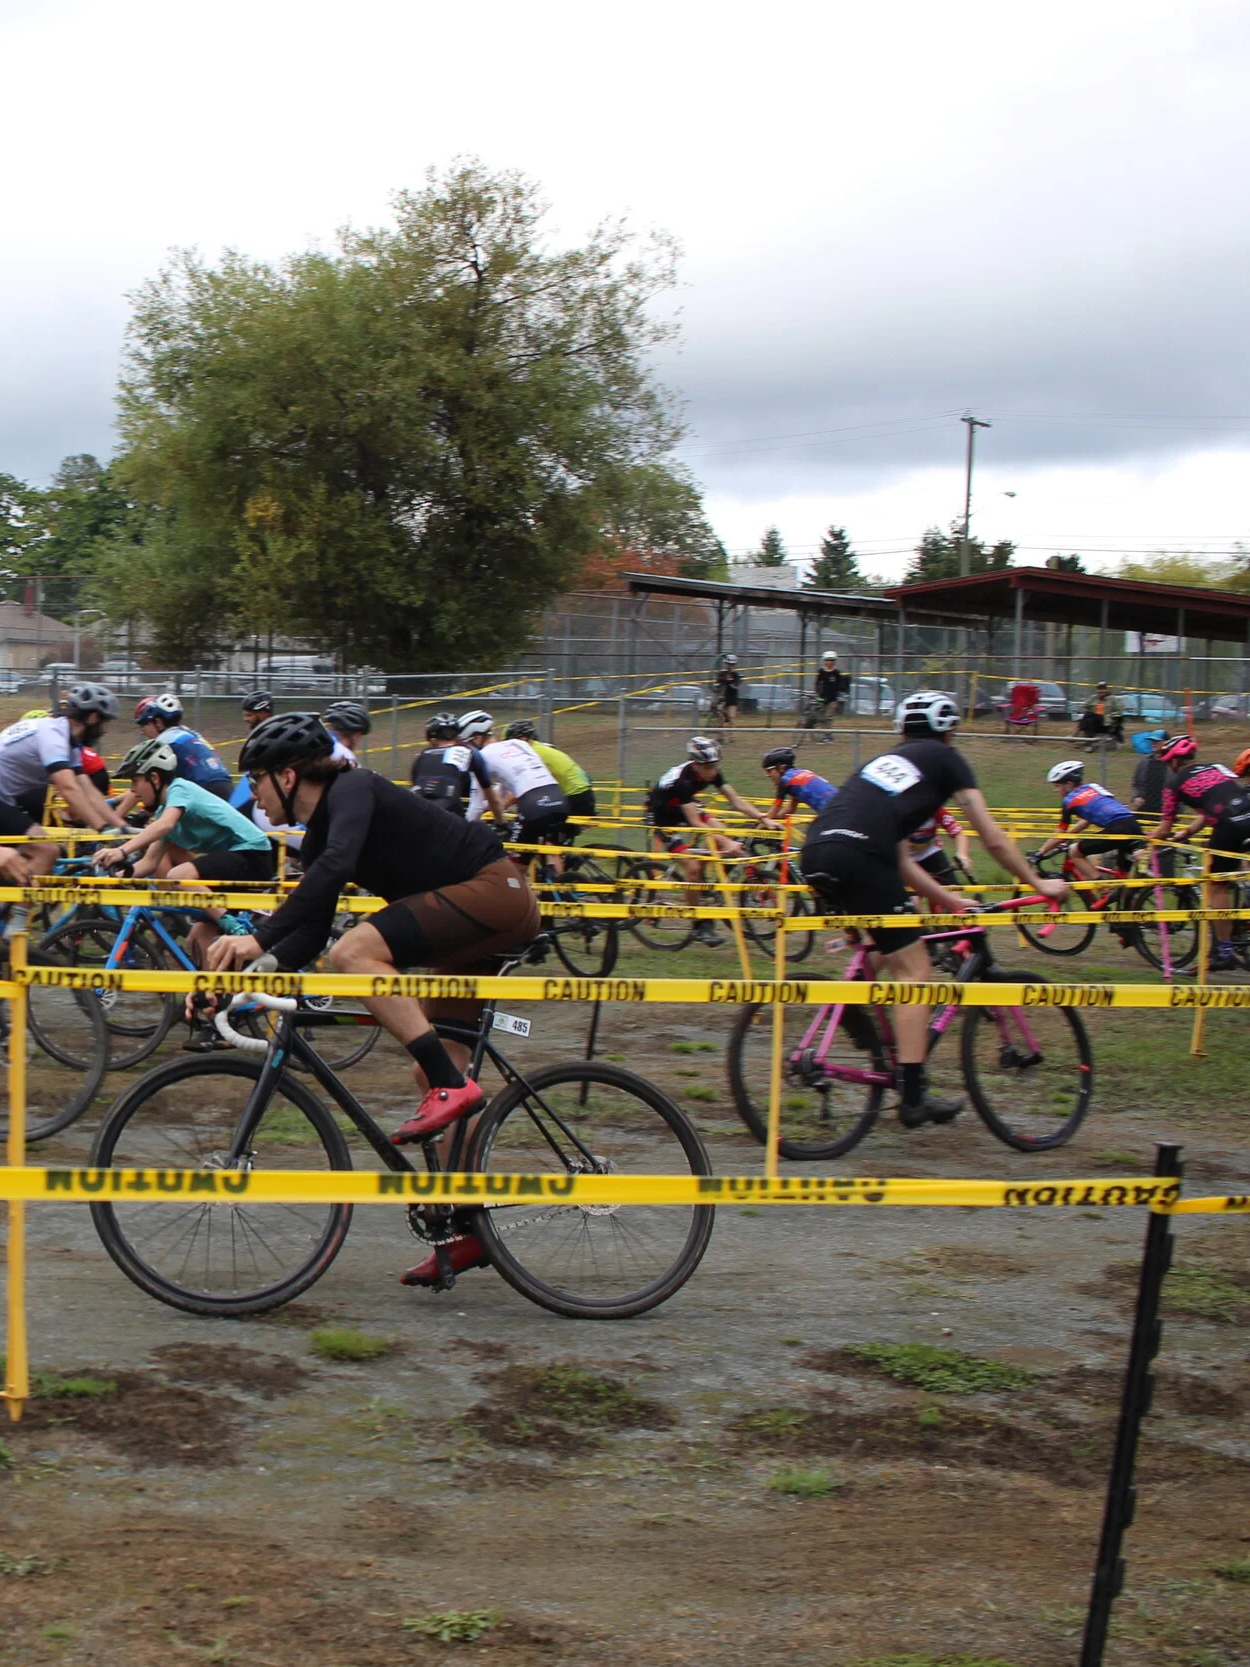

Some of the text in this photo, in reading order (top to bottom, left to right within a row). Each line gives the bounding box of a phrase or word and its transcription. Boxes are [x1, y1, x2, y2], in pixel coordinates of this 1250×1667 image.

[12, 966, 124, 990] CAUTION
[193, 974, 305, 996] CAUTION
[371, 976, 478, 999] CAUTION
[542, 979, 647, 1001] CAUTION
[707, 981, 810, 1004] CAUTION
[867, 983, 965, 1005] CAUTION
[1021, 985, 1115, 1007] CAUTION
[512, 1020, 529, 1033] 485
